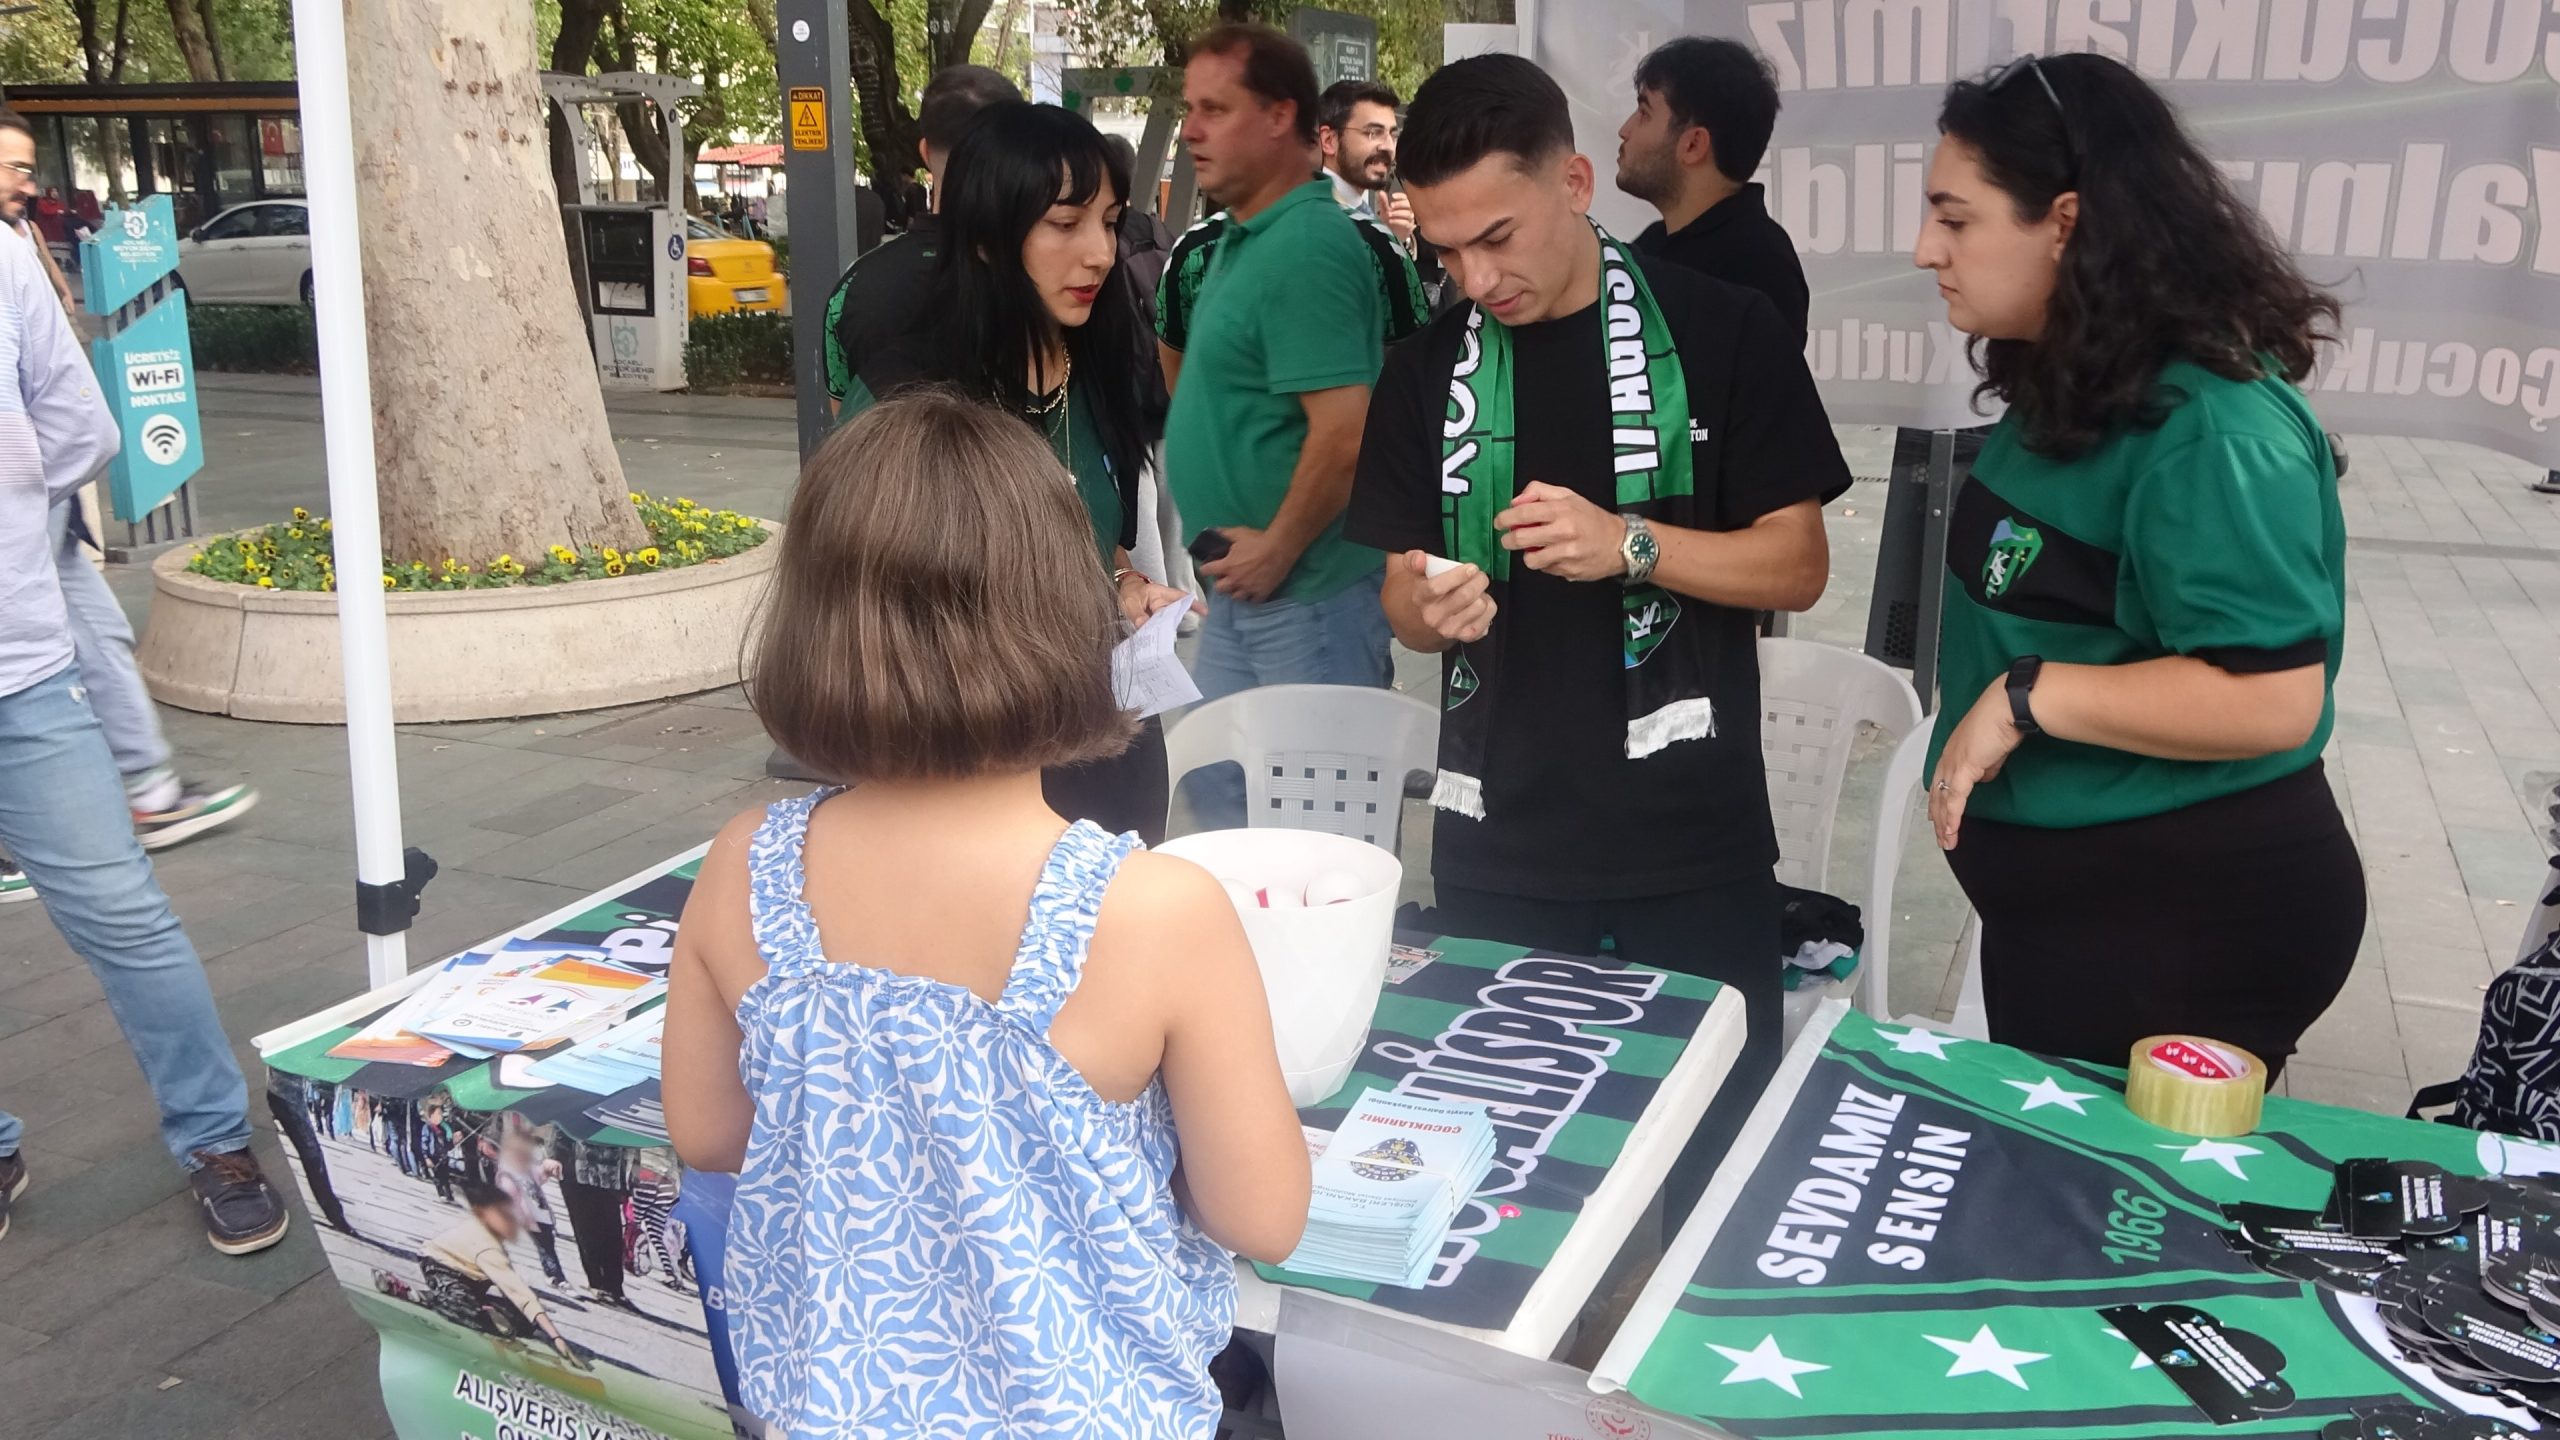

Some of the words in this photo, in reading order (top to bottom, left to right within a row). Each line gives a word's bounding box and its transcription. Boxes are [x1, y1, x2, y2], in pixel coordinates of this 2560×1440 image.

[130, 391, 187, 408] NOKTASI
[132, 368, 180, 387] Wi-Fi
[1359, 1112, 1463, 1135] ÇOCUKLARIMIZ
[1757, 1083, 1907, 1286] SEVDAMIZ
[1867, 1124, 1972, 1271] SENSİN
[2101, 1189, 2167, 1266] 1966
